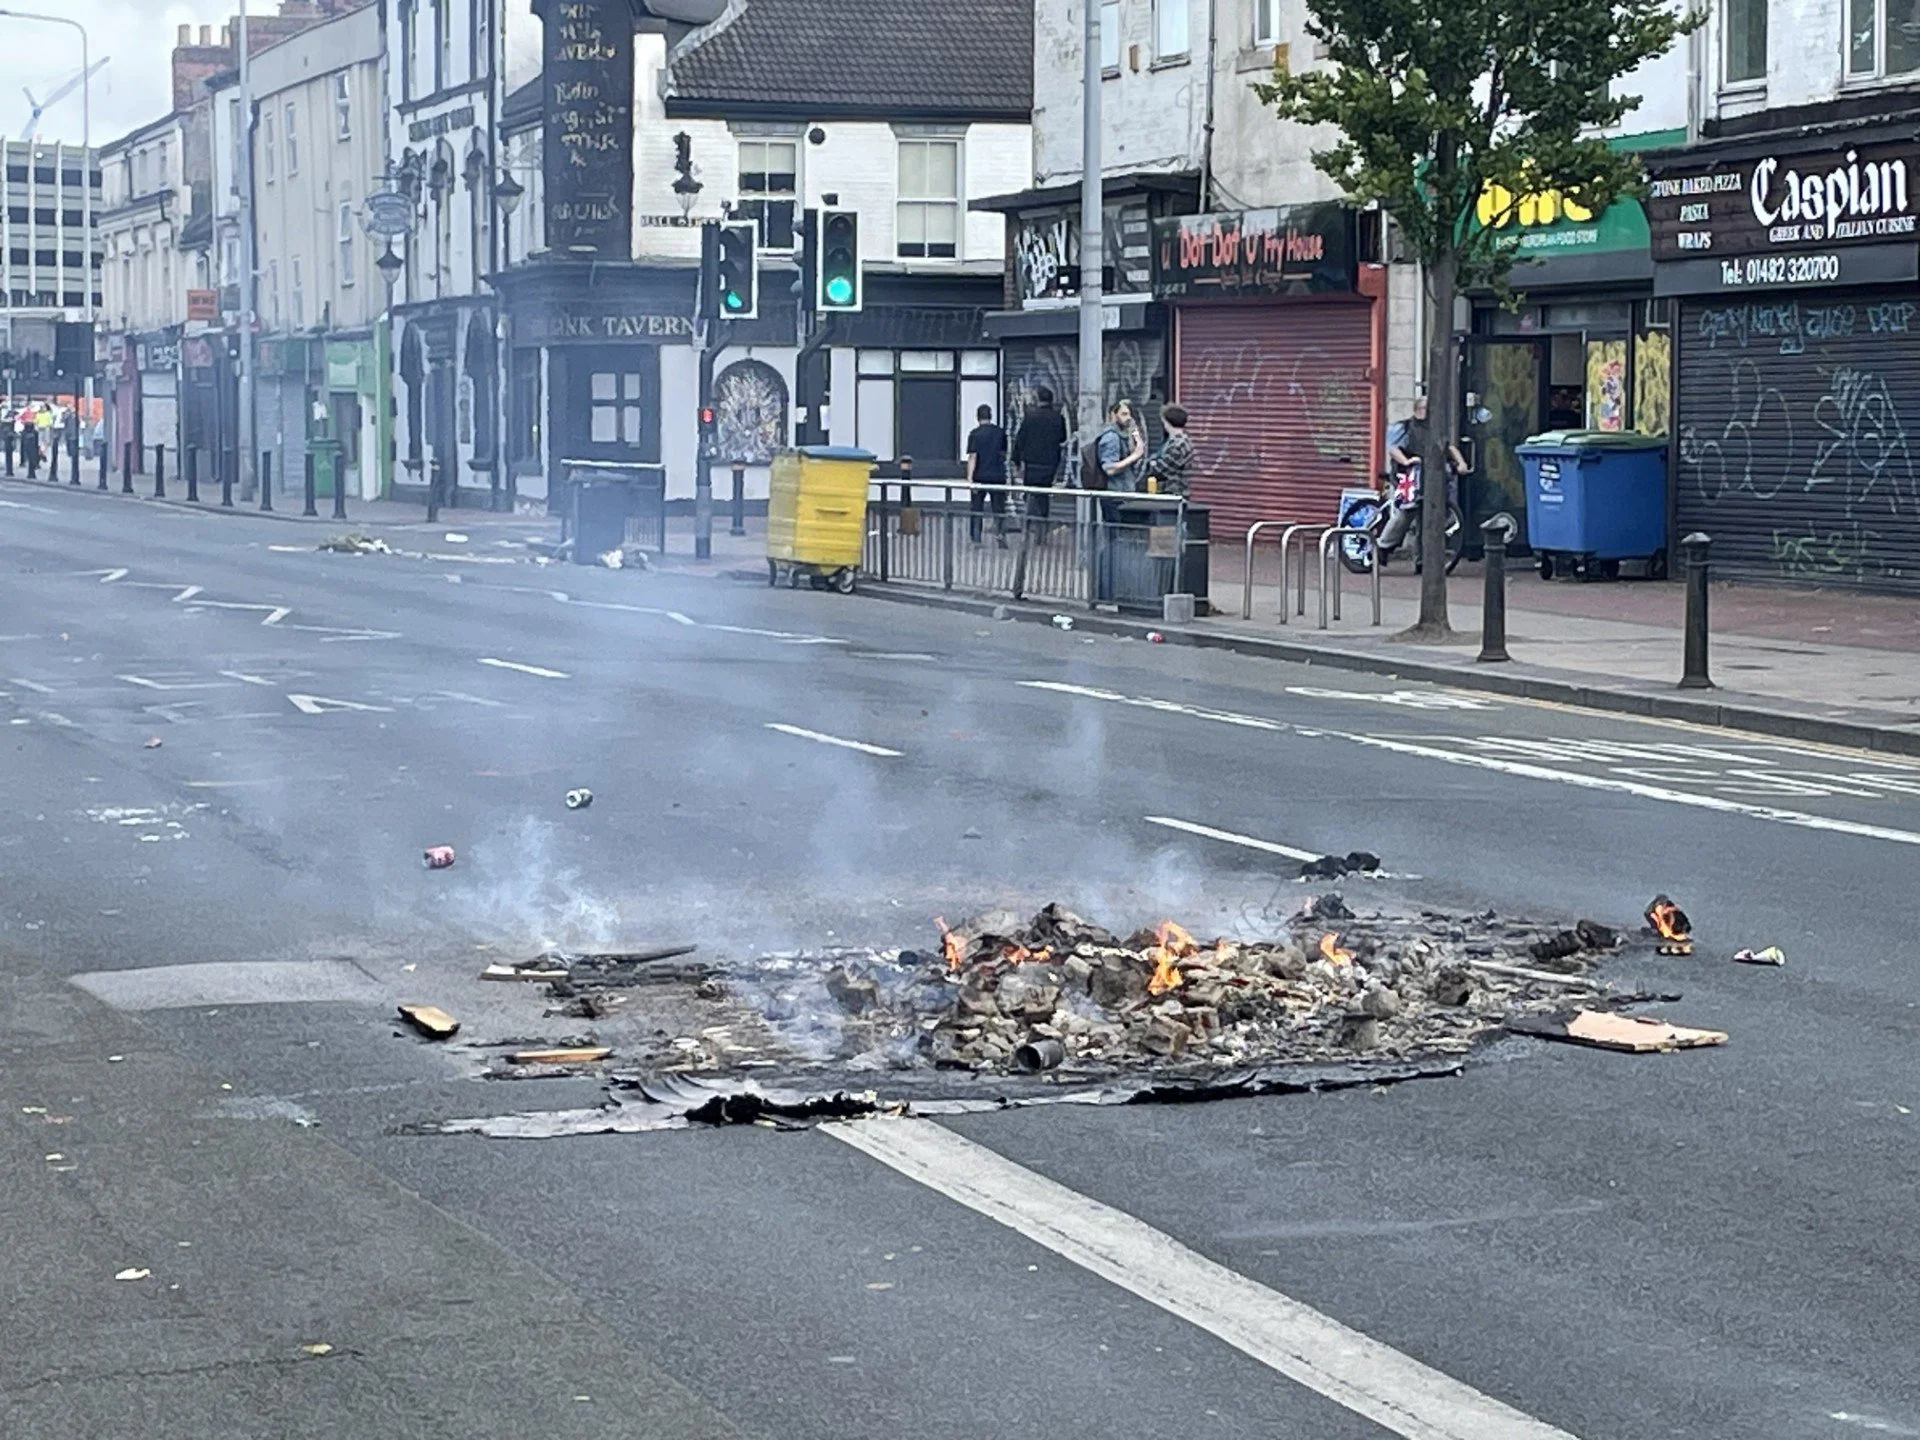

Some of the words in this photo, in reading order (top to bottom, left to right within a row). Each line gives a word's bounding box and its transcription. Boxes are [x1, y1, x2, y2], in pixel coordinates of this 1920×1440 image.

[1713, 173, 1742, 192] PIZZA
[1751, 149, 1908, 240] Caspian
[1680, 203, 1710, 222] PASTA
[1678, 231, 1712, 250] WRAPS
[1769, 225, 1801, 242] GREEK
[1801, 224, 1825, 240] AND
[1836, 220, 1875, 239] ITALIAN
[1876, 216, 1917, 234] CUISINE
[1747, 257, 1785, 284] 01482
[1787, 255, 1839, 283] 320700
[602, 314, 697, 337] TAVERN
